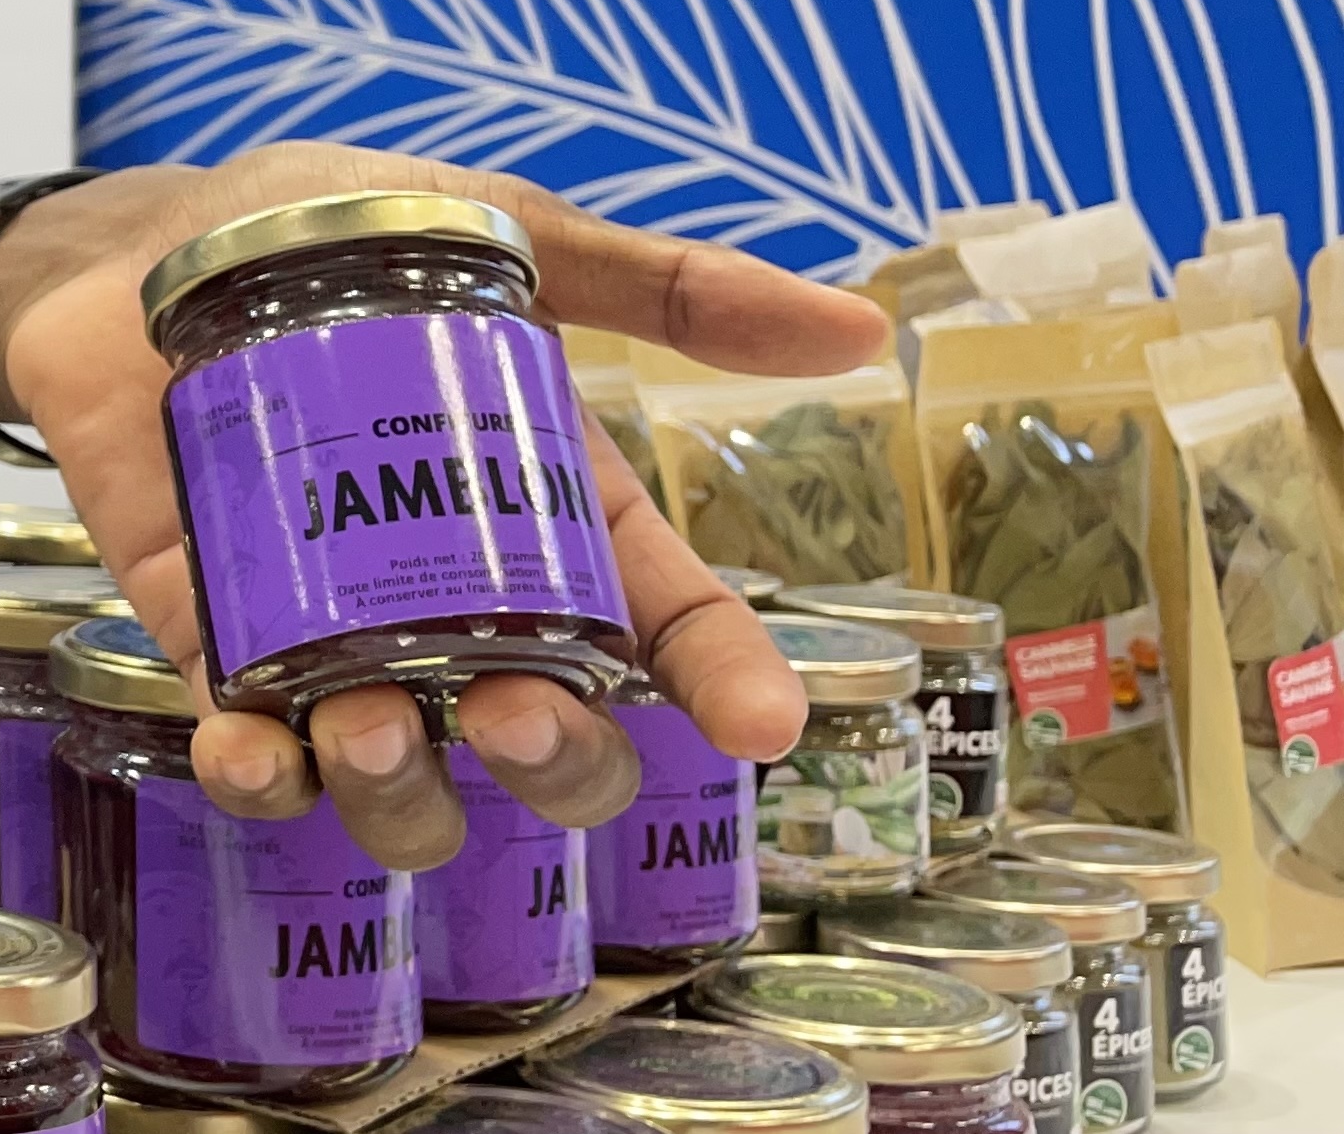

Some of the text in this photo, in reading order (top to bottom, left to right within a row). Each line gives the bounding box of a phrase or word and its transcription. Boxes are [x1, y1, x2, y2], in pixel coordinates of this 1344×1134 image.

[303, 456, 593, 540] JAMBLON
[390, 556, 429, 571] Poids
[434, 554, 456, 565] net
[337, 582, 369, 597] Date
[373, 575, 414, 590] limite
[419, 571, 437, 583] de
[369, 587, 440, 606] conserver
[445, 586, 463, 597] au
[927, 695, 955, 730] 4
[1181, 946, 1206, 982] 4
[1180, 977, 1226, 1009] ÉPIC
[1093, 997, 1121, 1033] 4
[1012, 1071, 1073, 1104] PICES
